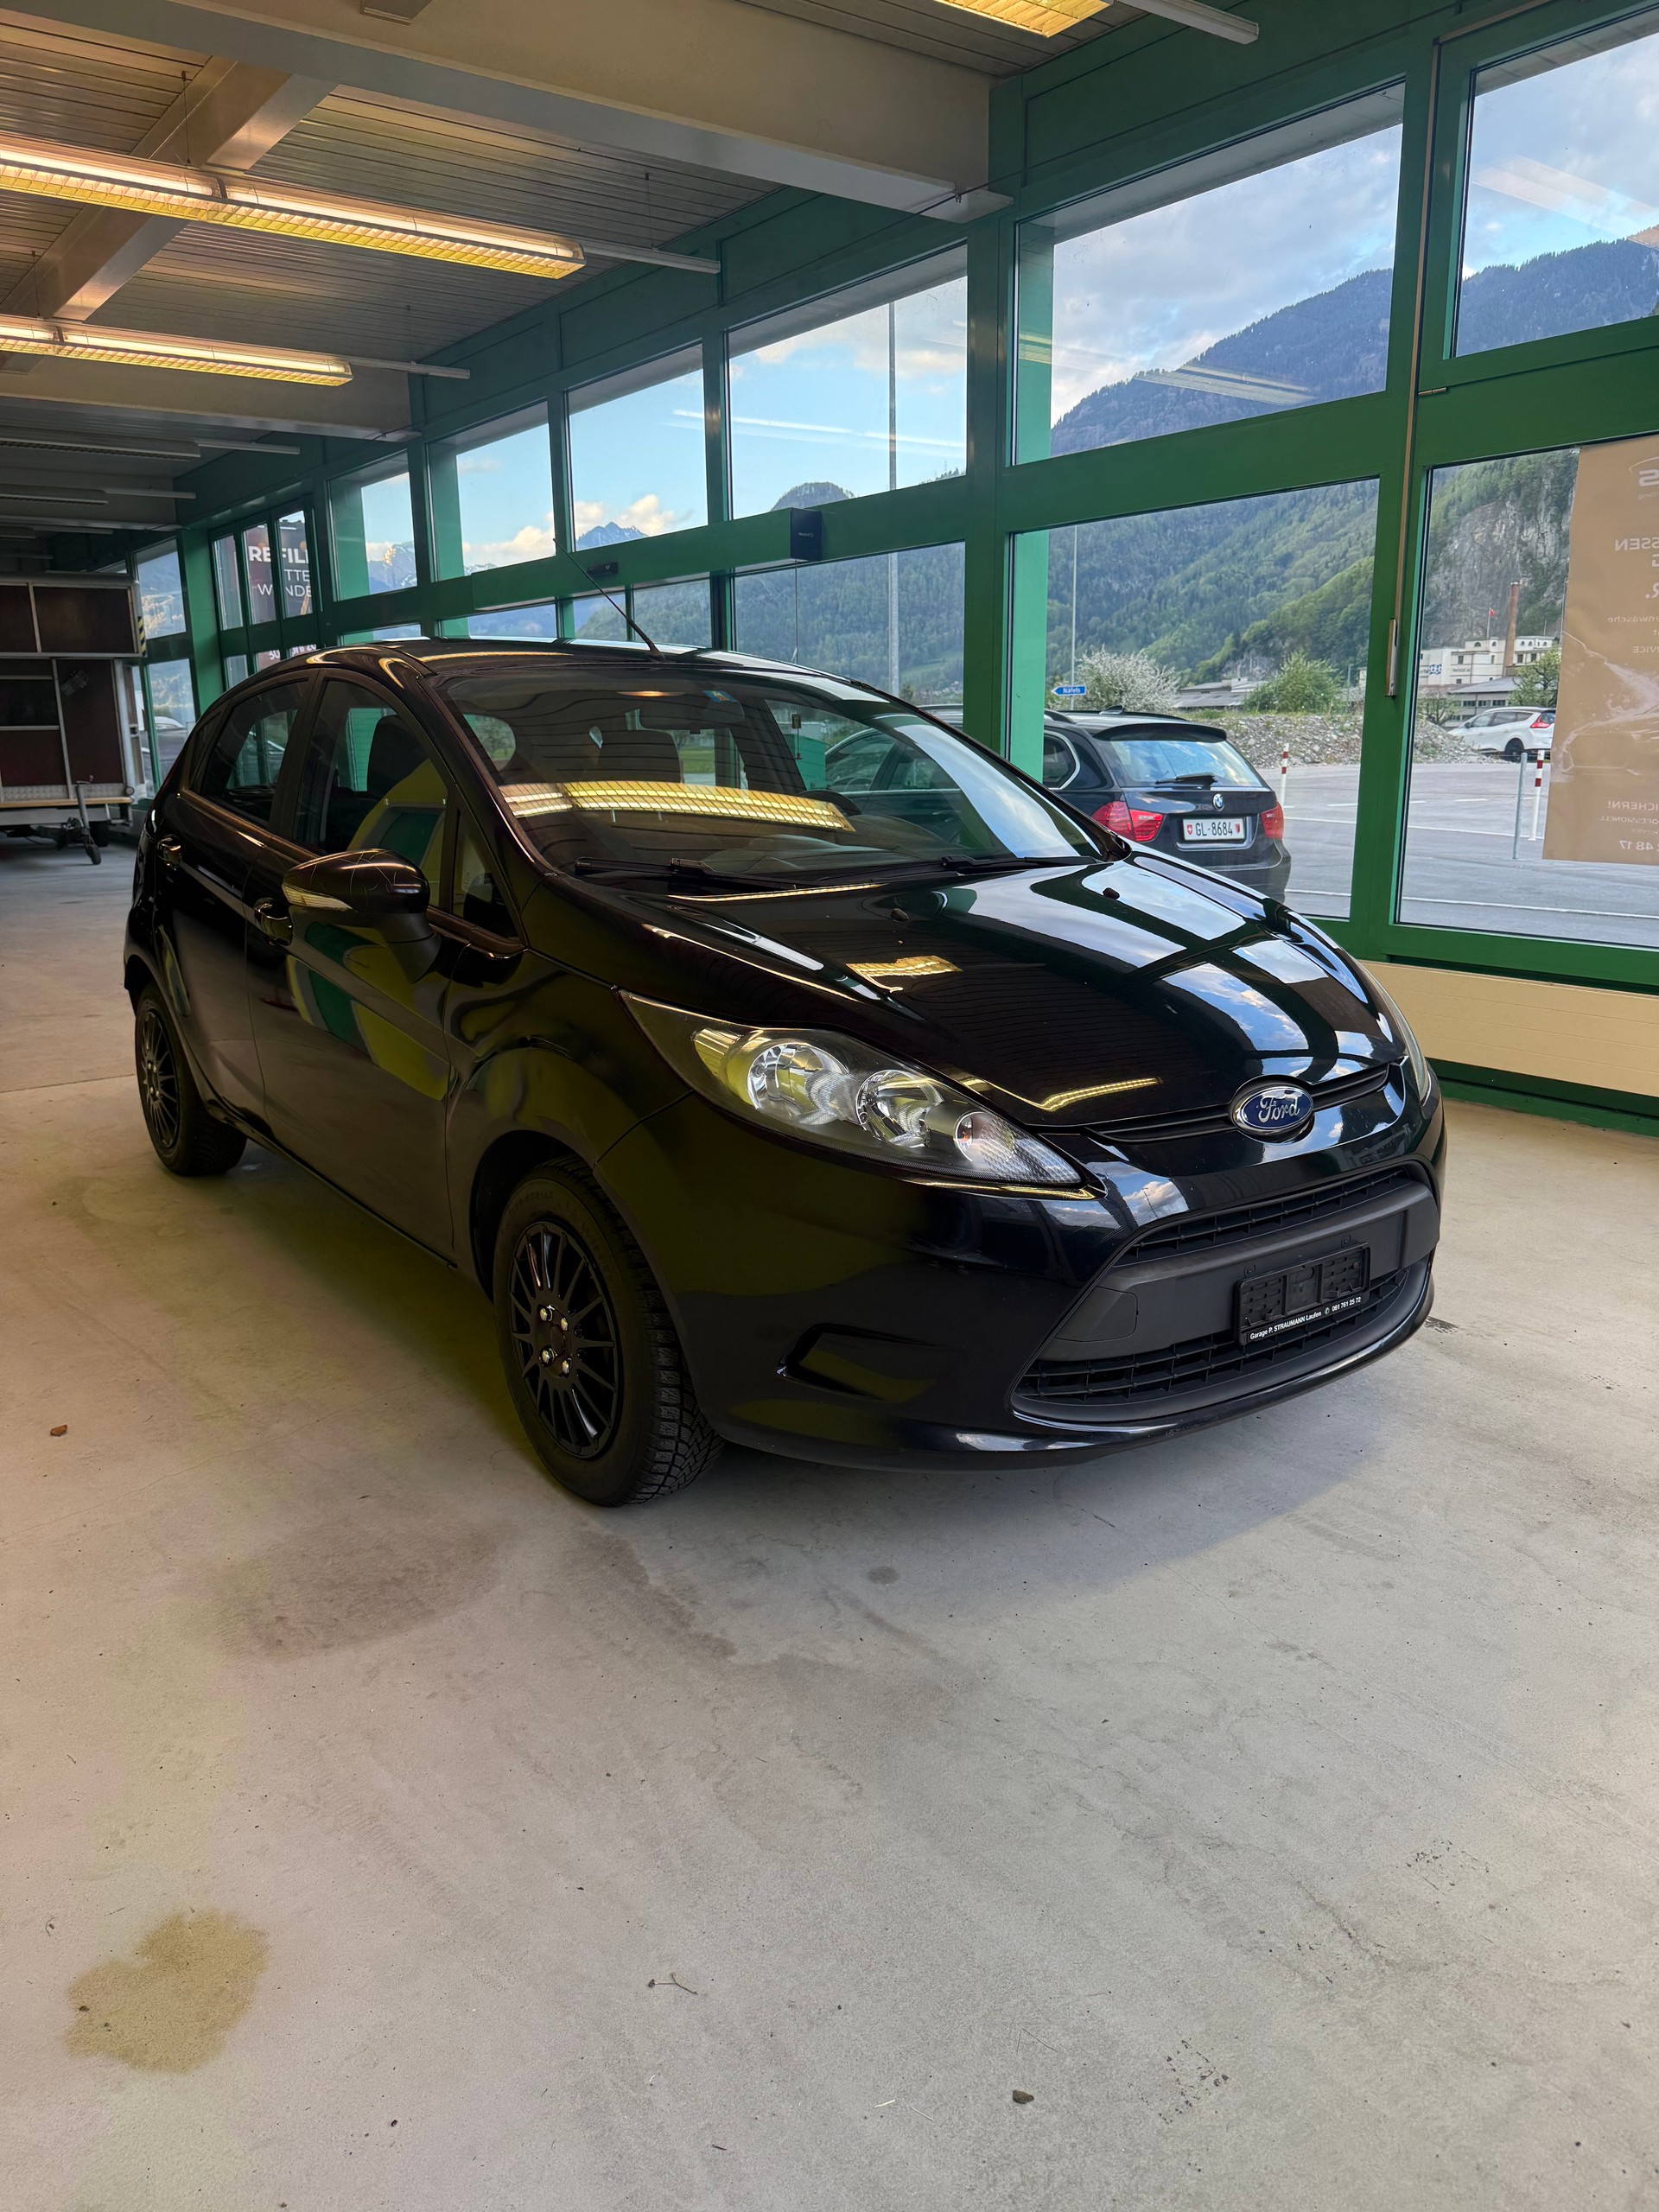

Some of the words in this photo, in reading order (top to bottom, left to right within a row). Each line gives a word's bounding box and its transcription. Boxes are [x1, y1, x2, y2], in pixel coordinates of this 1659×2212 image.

[257, 583, 311, 597] WNDE
[1258, 1094, 1300, 1123] Ford
[1250, 1330, 1268, 1339] Garage
[1274, 1316, 1306, 1332] STRAUMANN
[1306, 1312, 1322, 1321] Laufen
